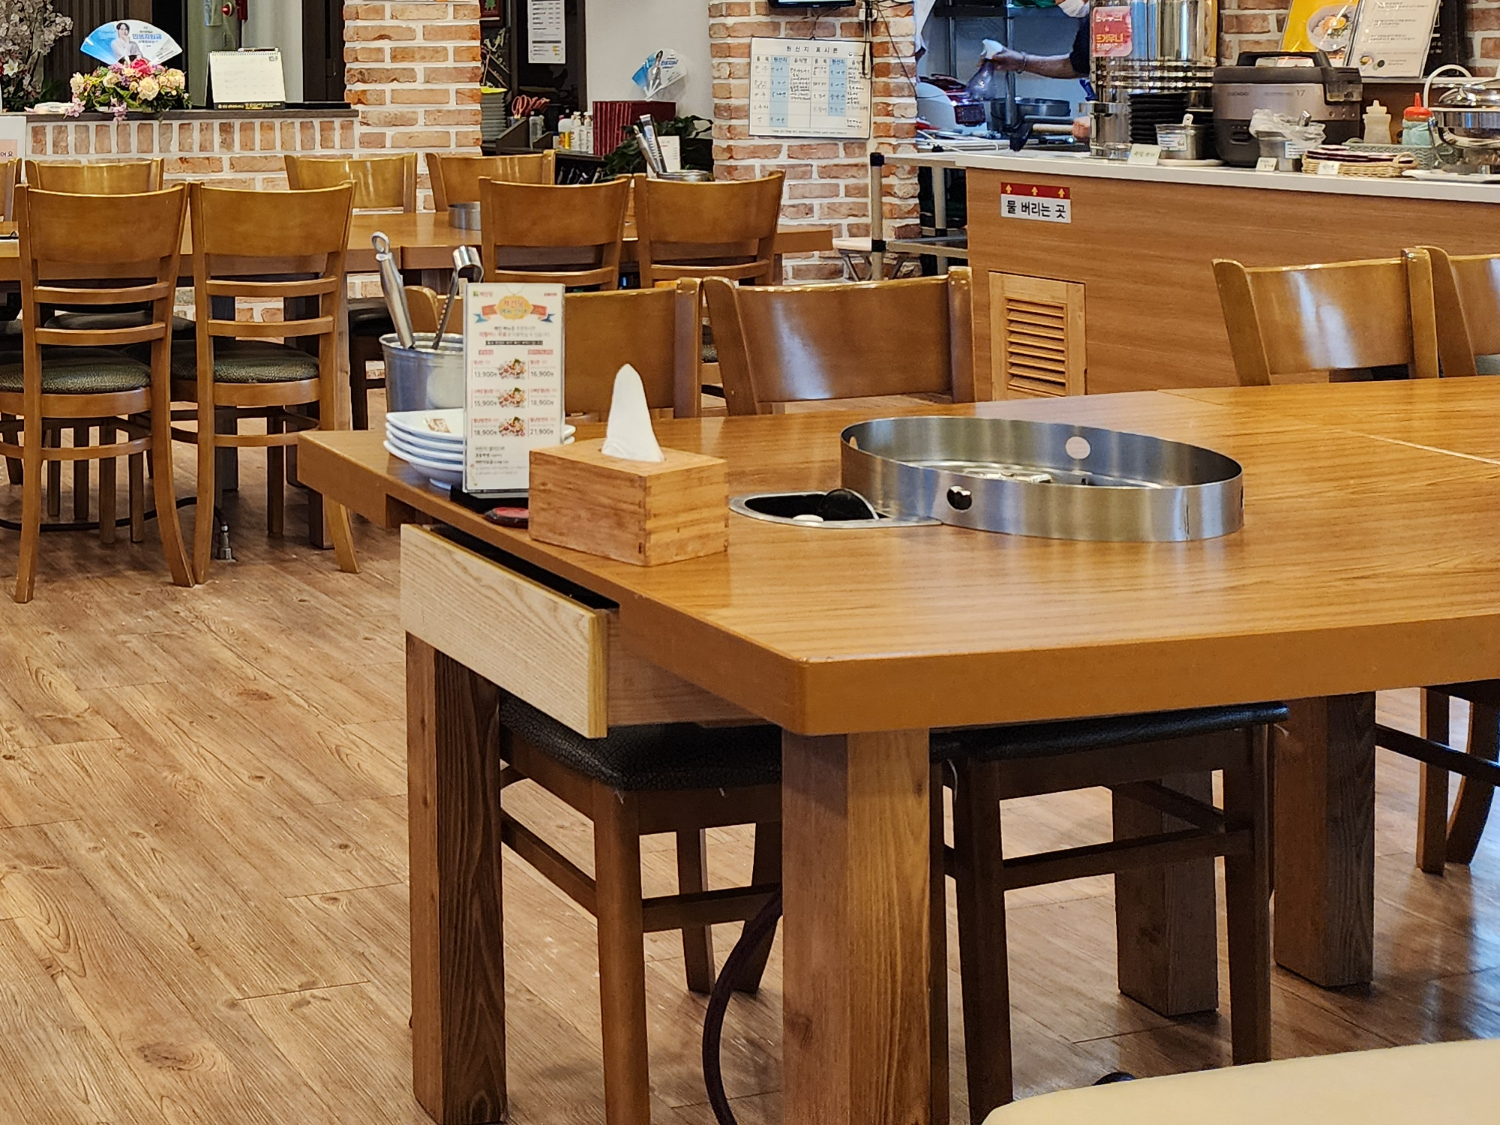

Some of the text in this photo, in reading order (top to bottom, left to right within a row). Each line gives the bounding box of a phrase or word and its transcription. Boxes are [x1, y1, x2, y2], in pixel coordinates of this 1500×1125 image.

[1296, 89, 1306, 97] 17
[1006, 200, 1067, 219] 물 버리는 곳
